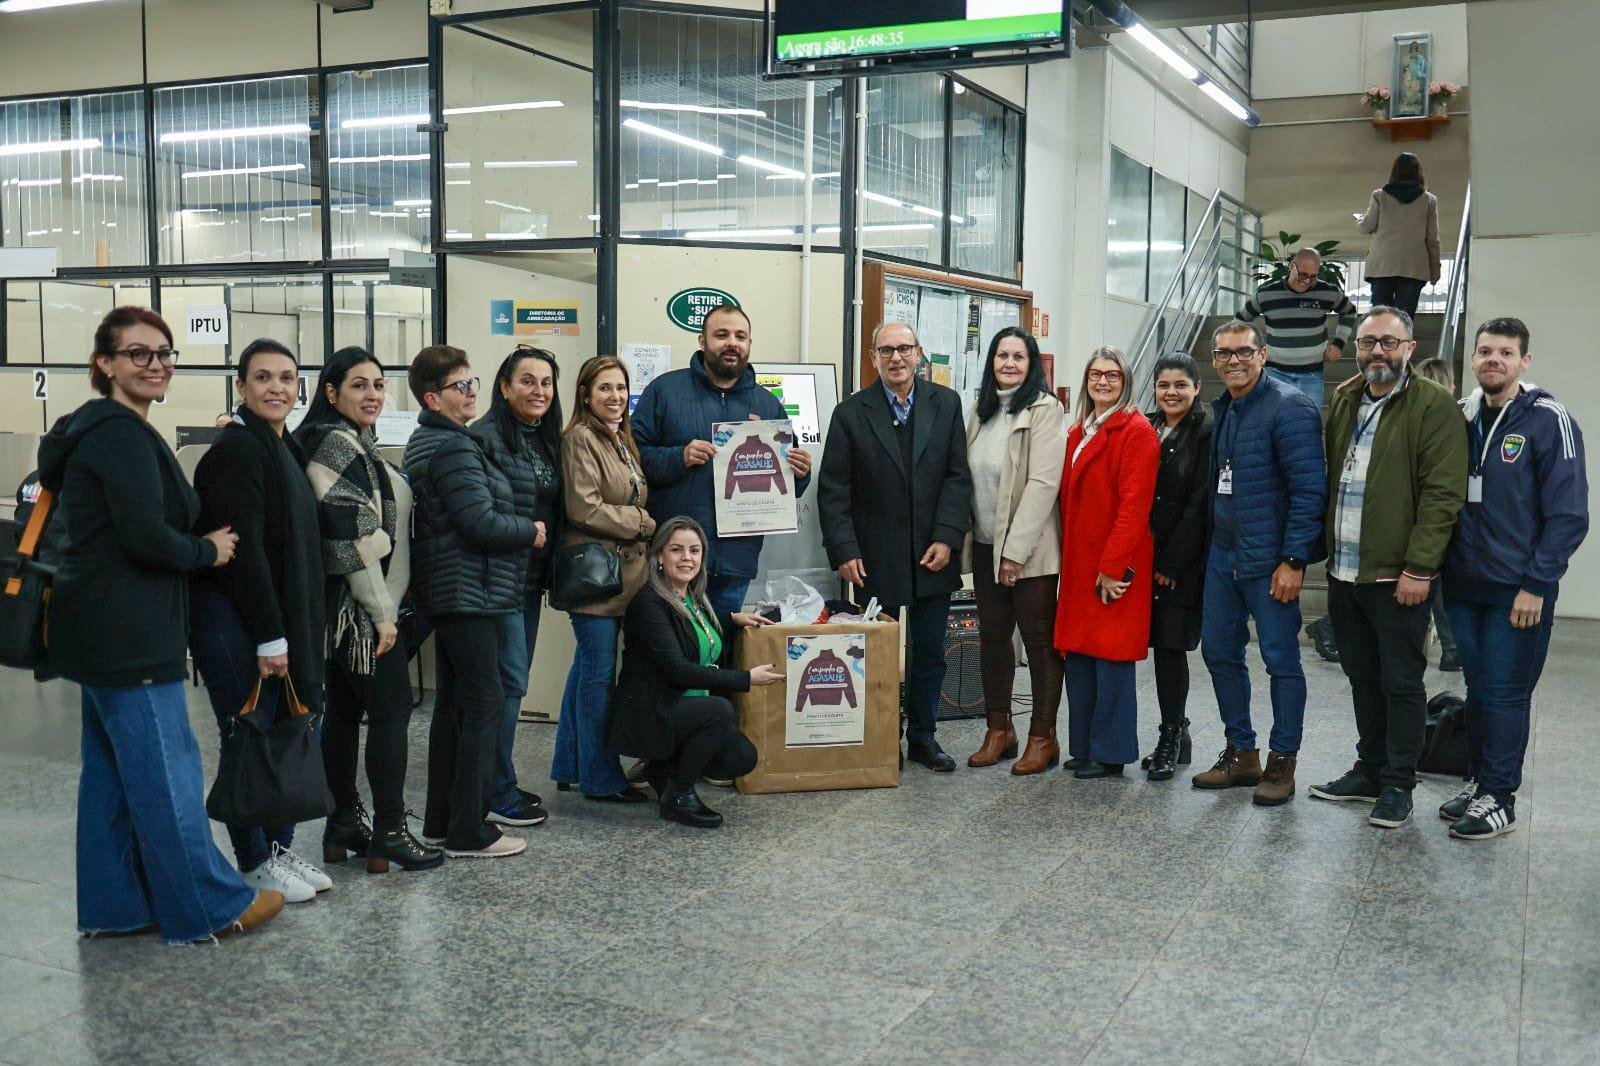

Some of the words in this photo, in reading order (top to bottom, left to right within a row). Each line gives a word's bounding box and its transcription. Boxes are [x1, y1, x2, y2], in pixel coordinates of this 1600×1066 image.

[785, 41, 821, 57] Agora
[824, 38, 845, 49] são
[850, 31, 904, 48] 16:48:35
[687, 294, 723, 305] RETIRE
[190, 318, 222, 333] IPTU
[35, 371, 46, 398] 2
[737, 460, 773, 469] AGASALHO
[809, 674, 845, 682] AGASALHO
